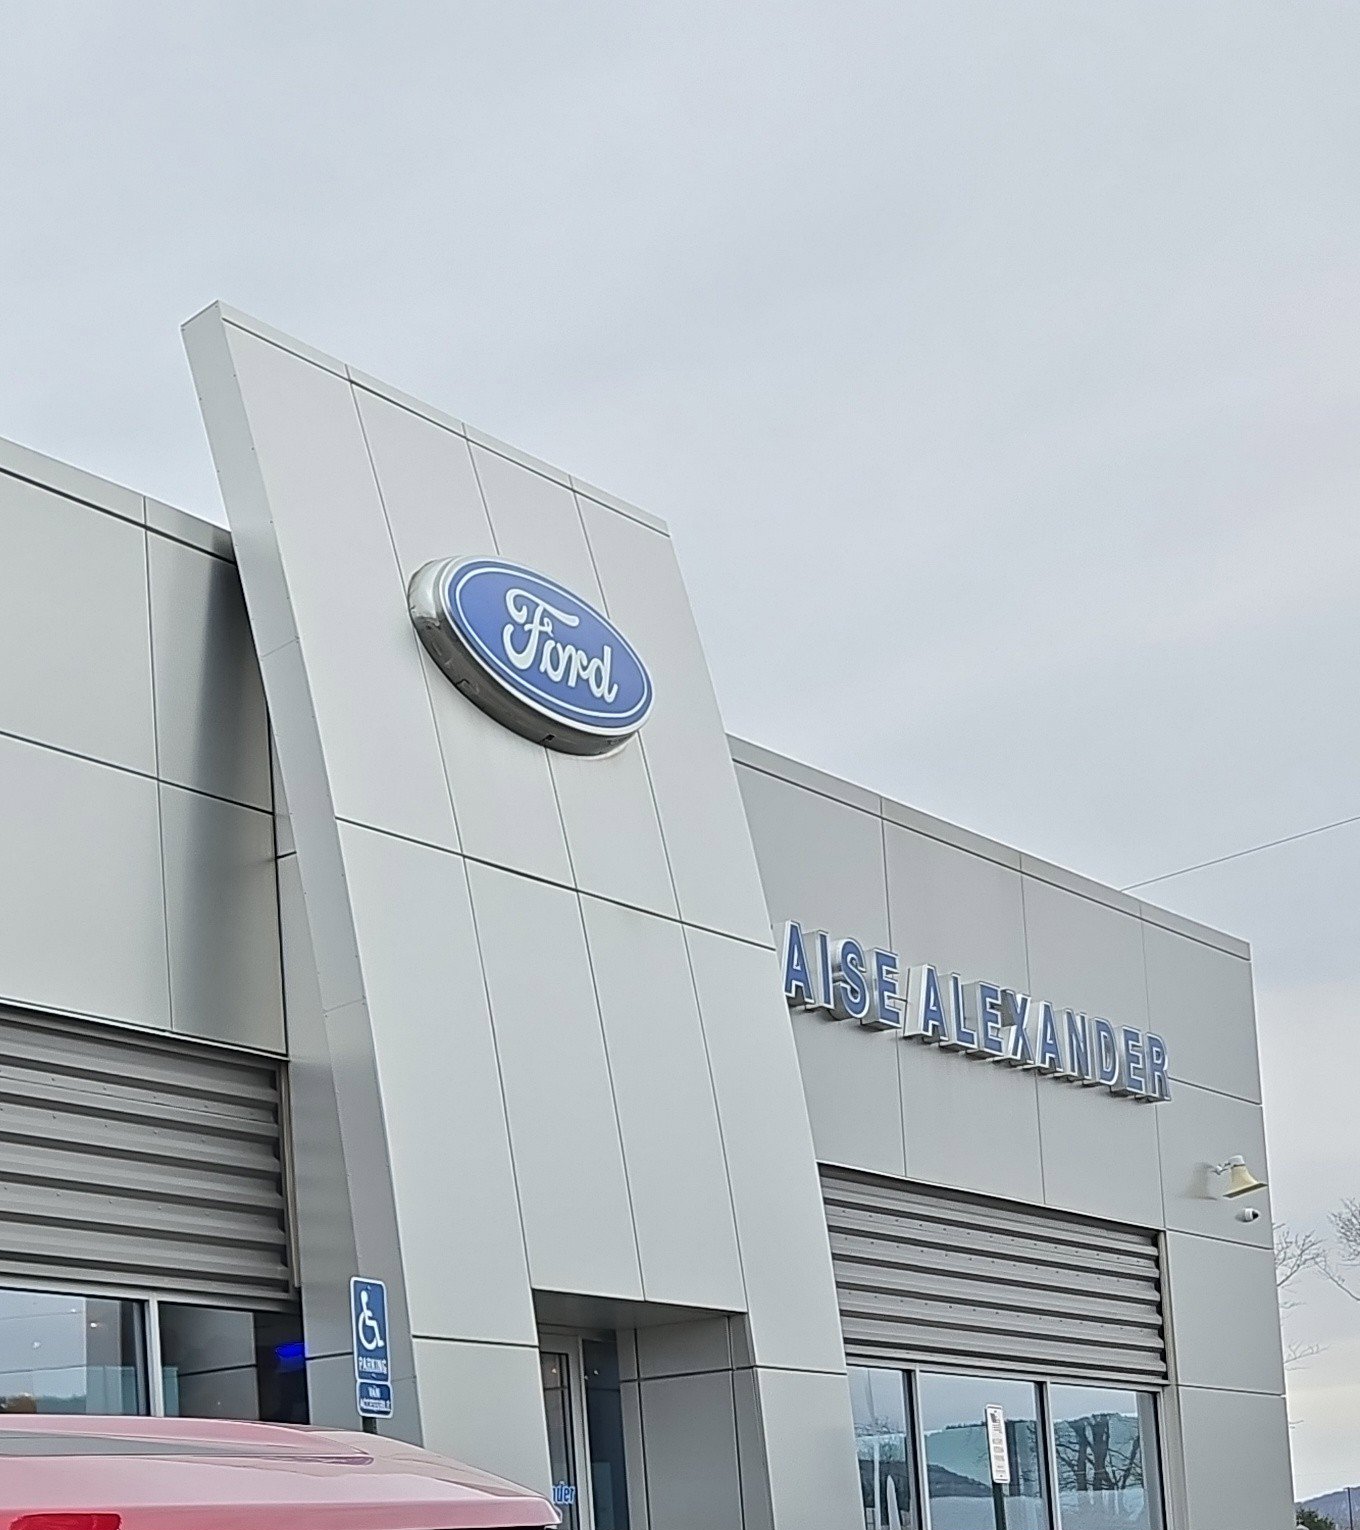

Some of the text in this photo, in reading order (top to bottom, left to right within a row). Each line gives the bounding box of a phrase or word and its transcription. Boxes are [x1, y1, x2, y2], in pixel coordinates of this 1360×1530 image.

[502, 588, 618, 703] Ford
[783, 919, 1172, 1101] AISE ALEXANDER
[358, 1356, 388, 1375] PARKING
